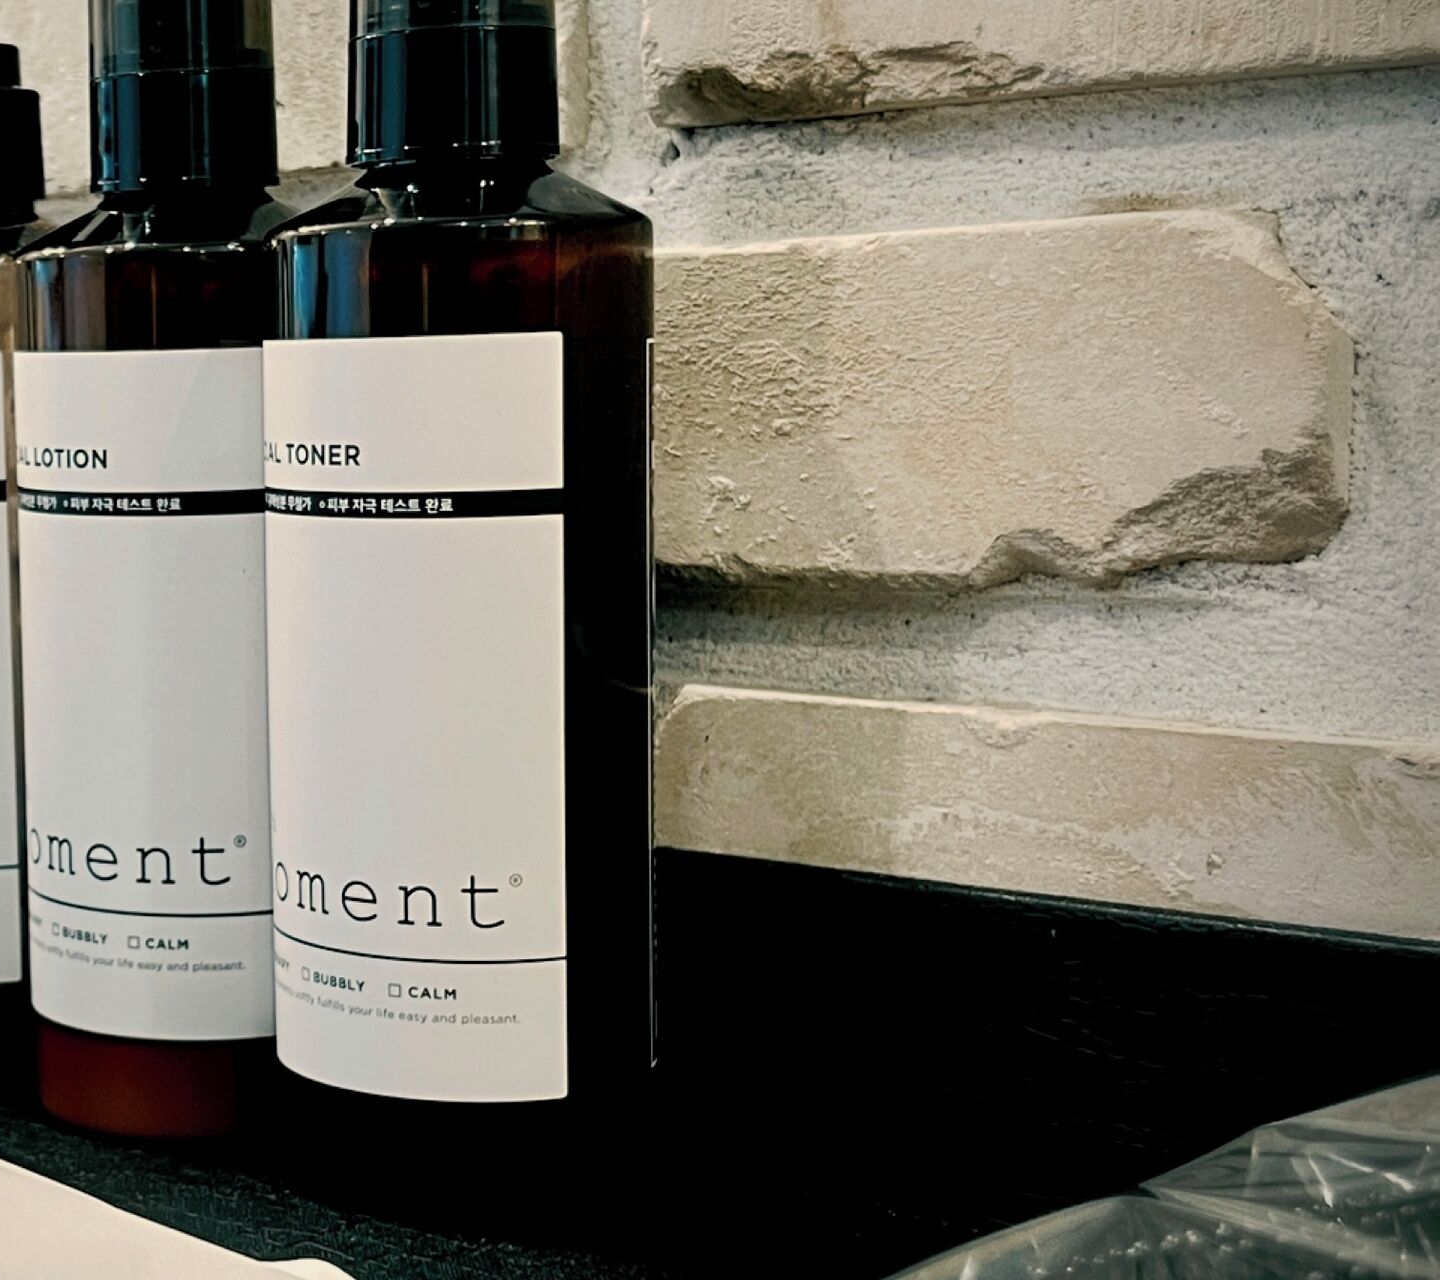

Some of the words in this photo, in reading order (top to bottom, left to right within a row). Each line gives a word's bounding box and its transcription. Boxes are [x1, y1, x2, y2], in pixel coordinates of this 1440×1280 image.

[34, 447, 108, 469] LOTION
[286, 443, 360, 466] TONER
[117, 498, 153, 512] 테스트
[327, 497, 350, 513] 피부
[352, 498, 377, 514] 자극
[381, 498, 421, 513] 테스트
[425, 498, 454, 514] 완료
[62, 926, 108, 945] BUBBLY
[145, 937, 190, 950] CALM
[137, 961, 162, 972] easy
[167, 960, 189, 971] and
[313, 971, 365, 992] BUBBLY
[408, 986, 457, 1000] CALM
[348, 1004, 373, 1018] your
[376, 1007, 395, 1020] life
[398, 1011, 427, 1024] easy
[431, 1011, 457, 1024] and
[461, 1013, 521, 1026] pleasant.
